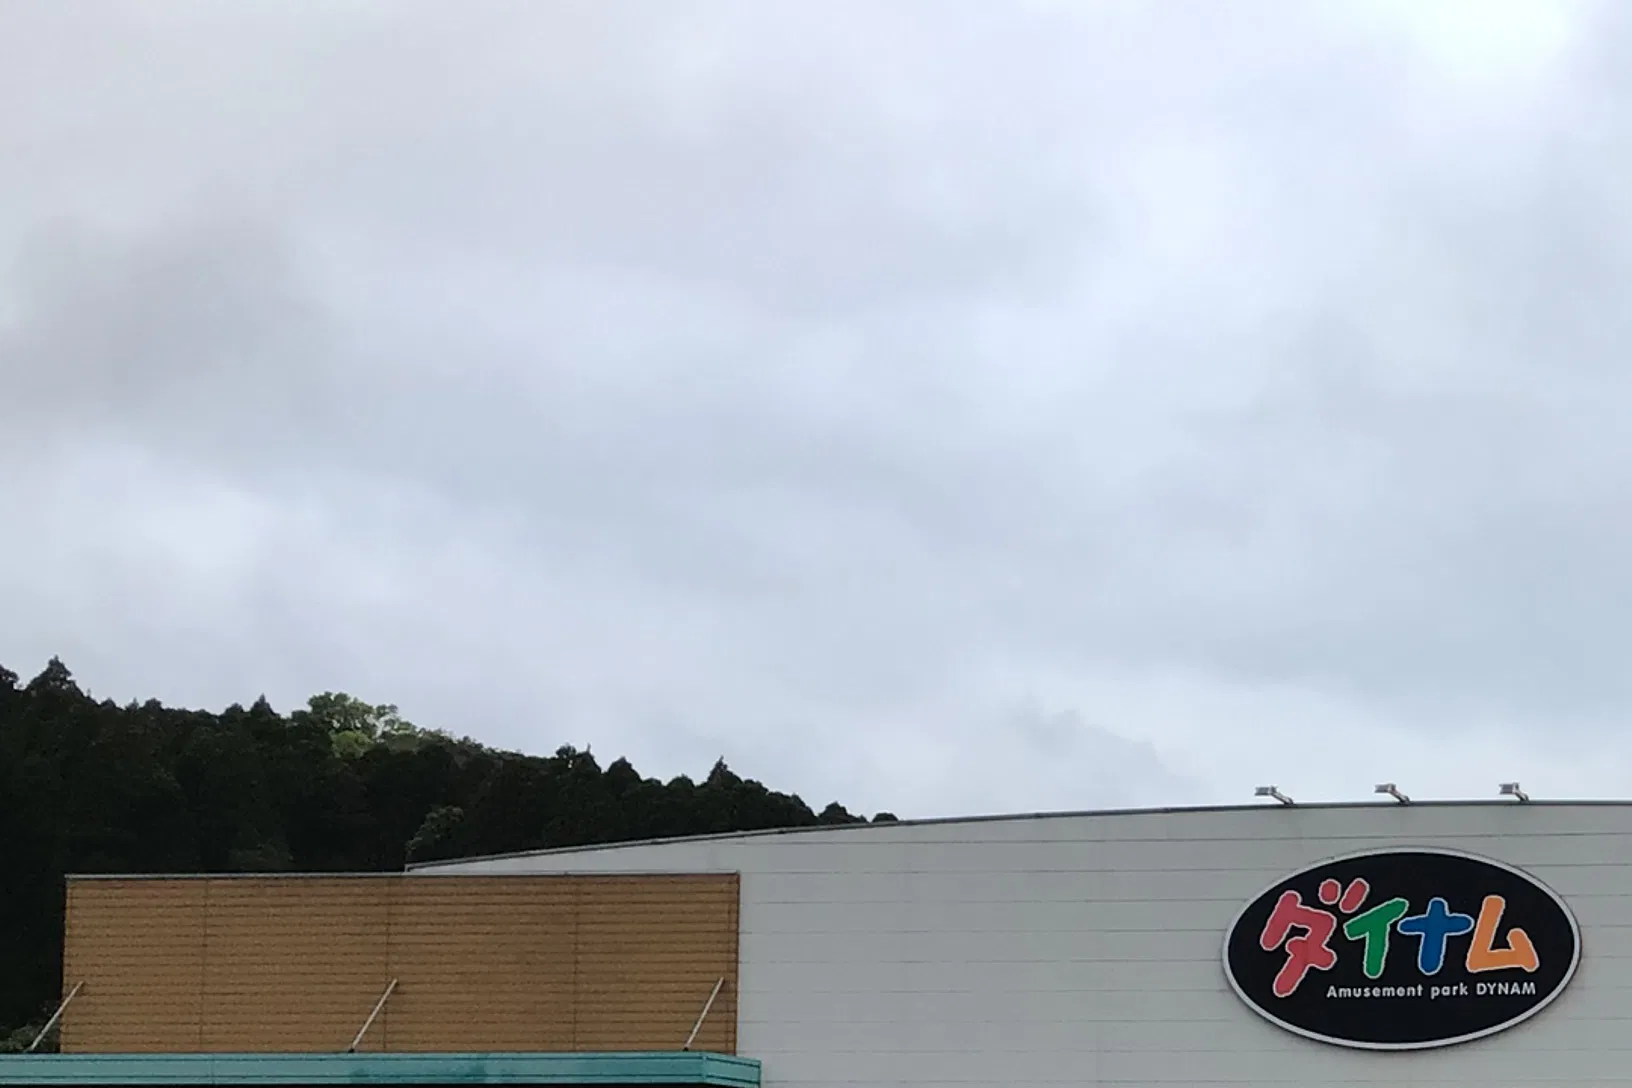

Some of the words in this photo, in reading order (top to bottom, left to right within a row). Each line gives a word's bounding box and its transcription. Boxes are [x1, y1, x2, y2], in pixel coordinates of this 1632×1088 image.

[1260, 878, 1539, 997] ダイナム
[1326, 984, 1423, 998] Amusement
[1430, 982, 1468, 999] park
[1476, 982, 1536, 995] DYNAM
